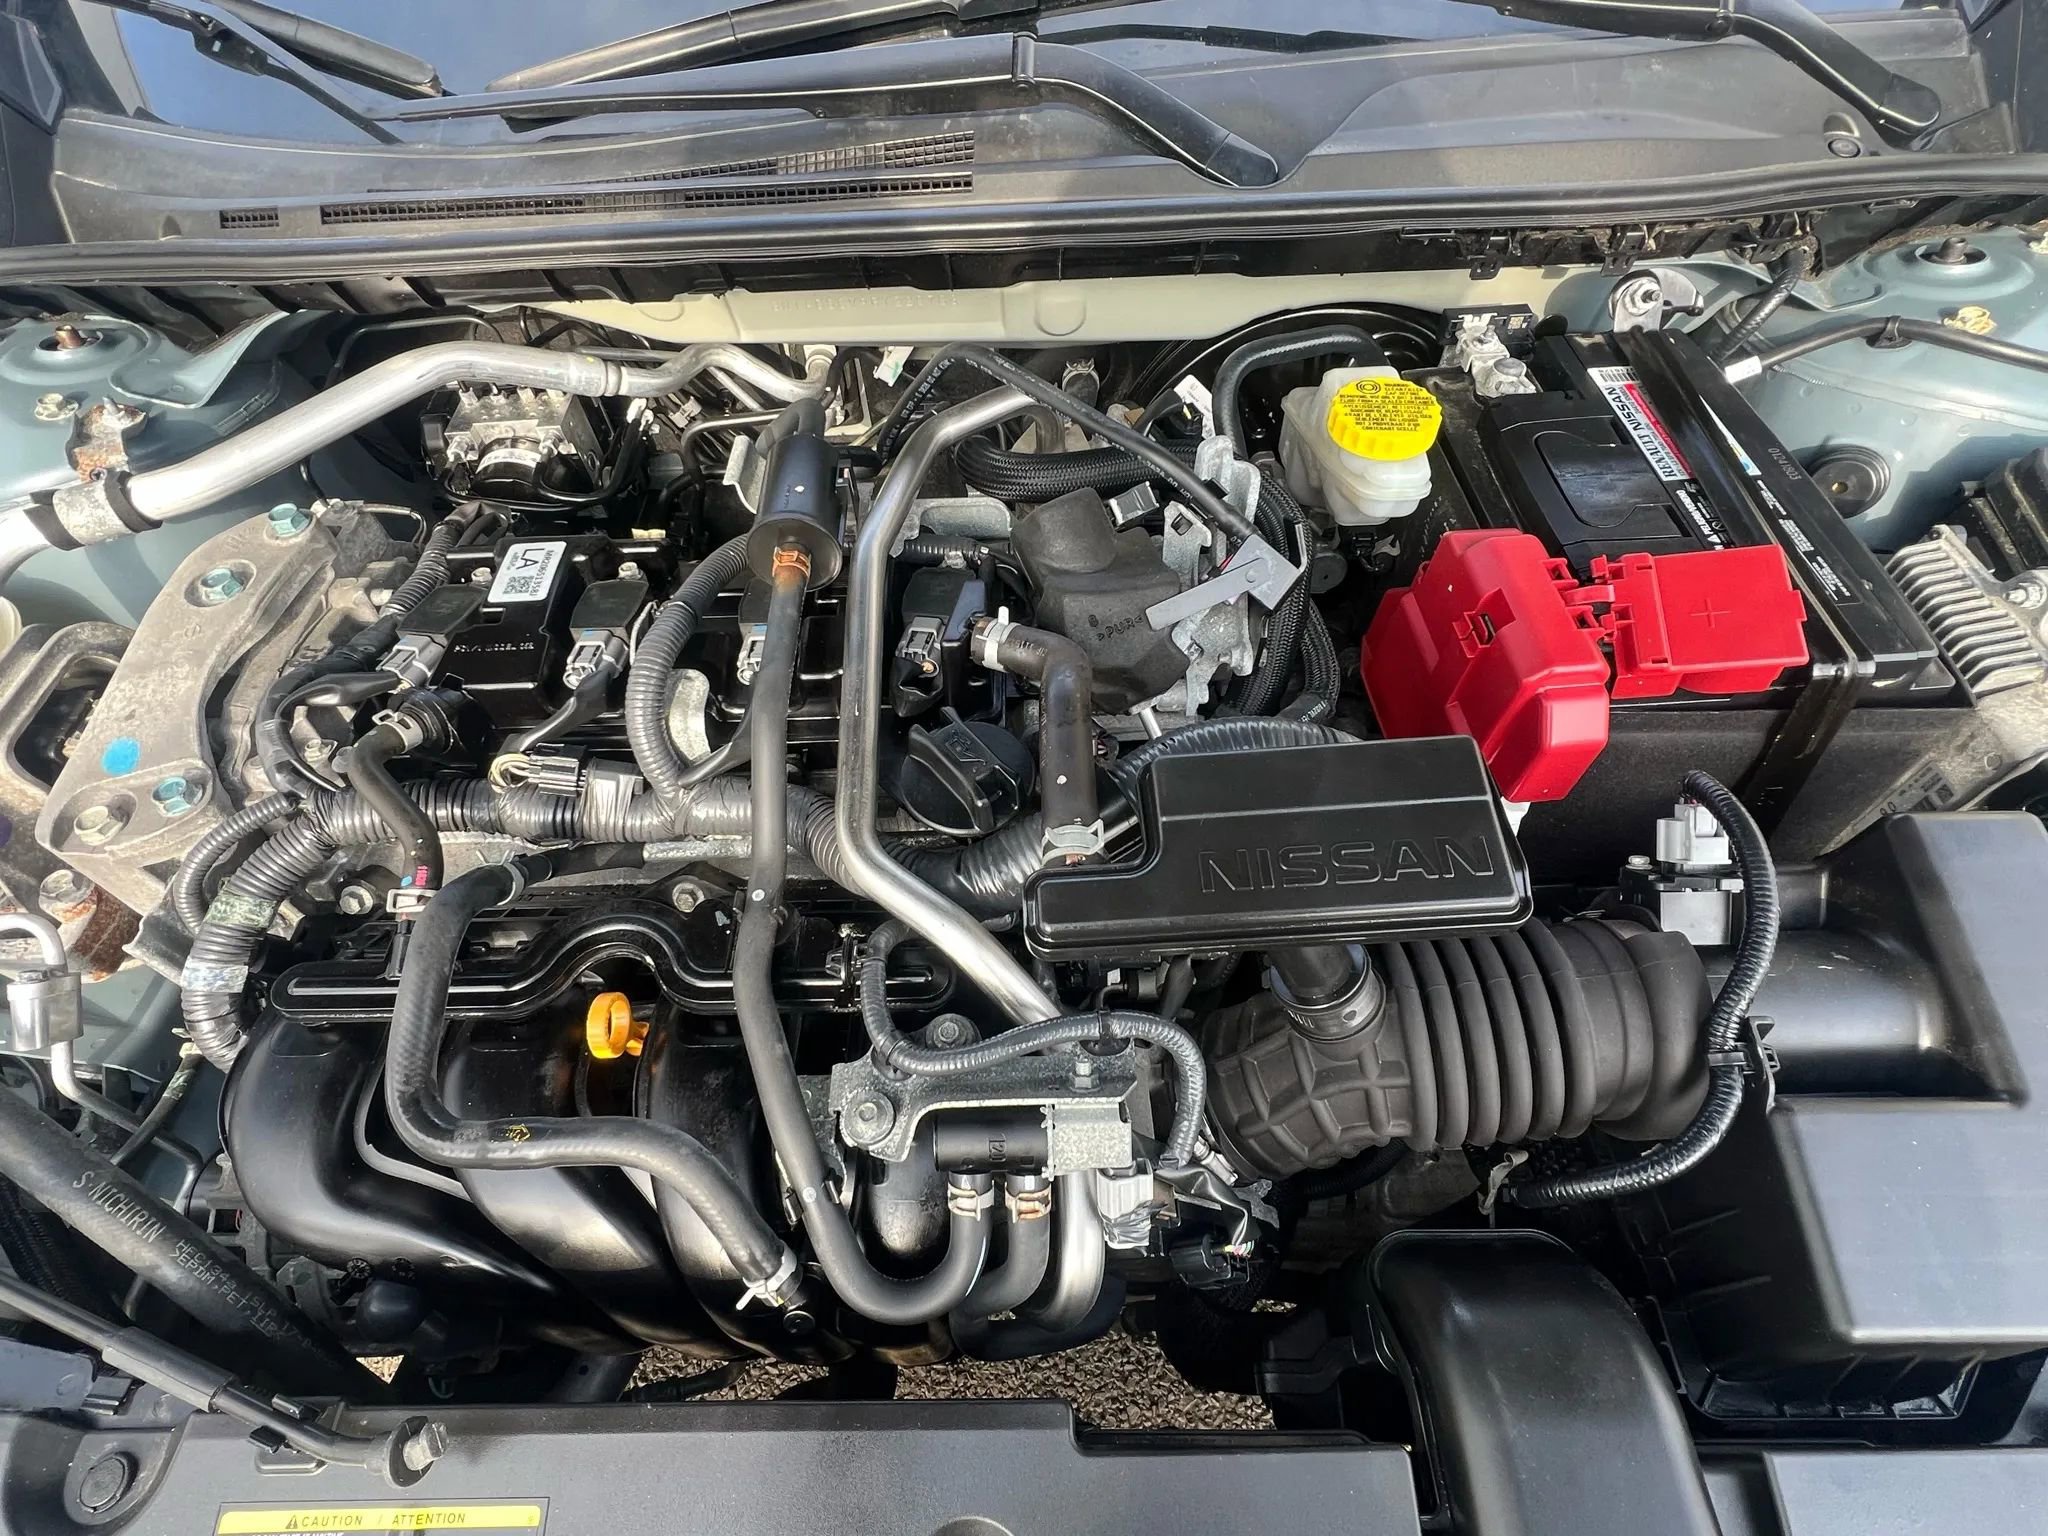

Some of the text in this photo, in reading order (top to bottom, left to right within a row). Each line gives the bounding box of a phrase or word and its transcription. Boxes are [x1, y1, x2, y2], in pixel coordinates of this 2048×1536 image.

[1605, 386, 1643, 432] NISSAN
[1638, 434, 1678, 478] RENAULT
[515, 548, 546, 570] LA
[1199, 835, 1495, 893] NISSAN
[301, 1515, 363, 1527] CAUTION
[392, 1513, 466, 1525] ATTENTION
